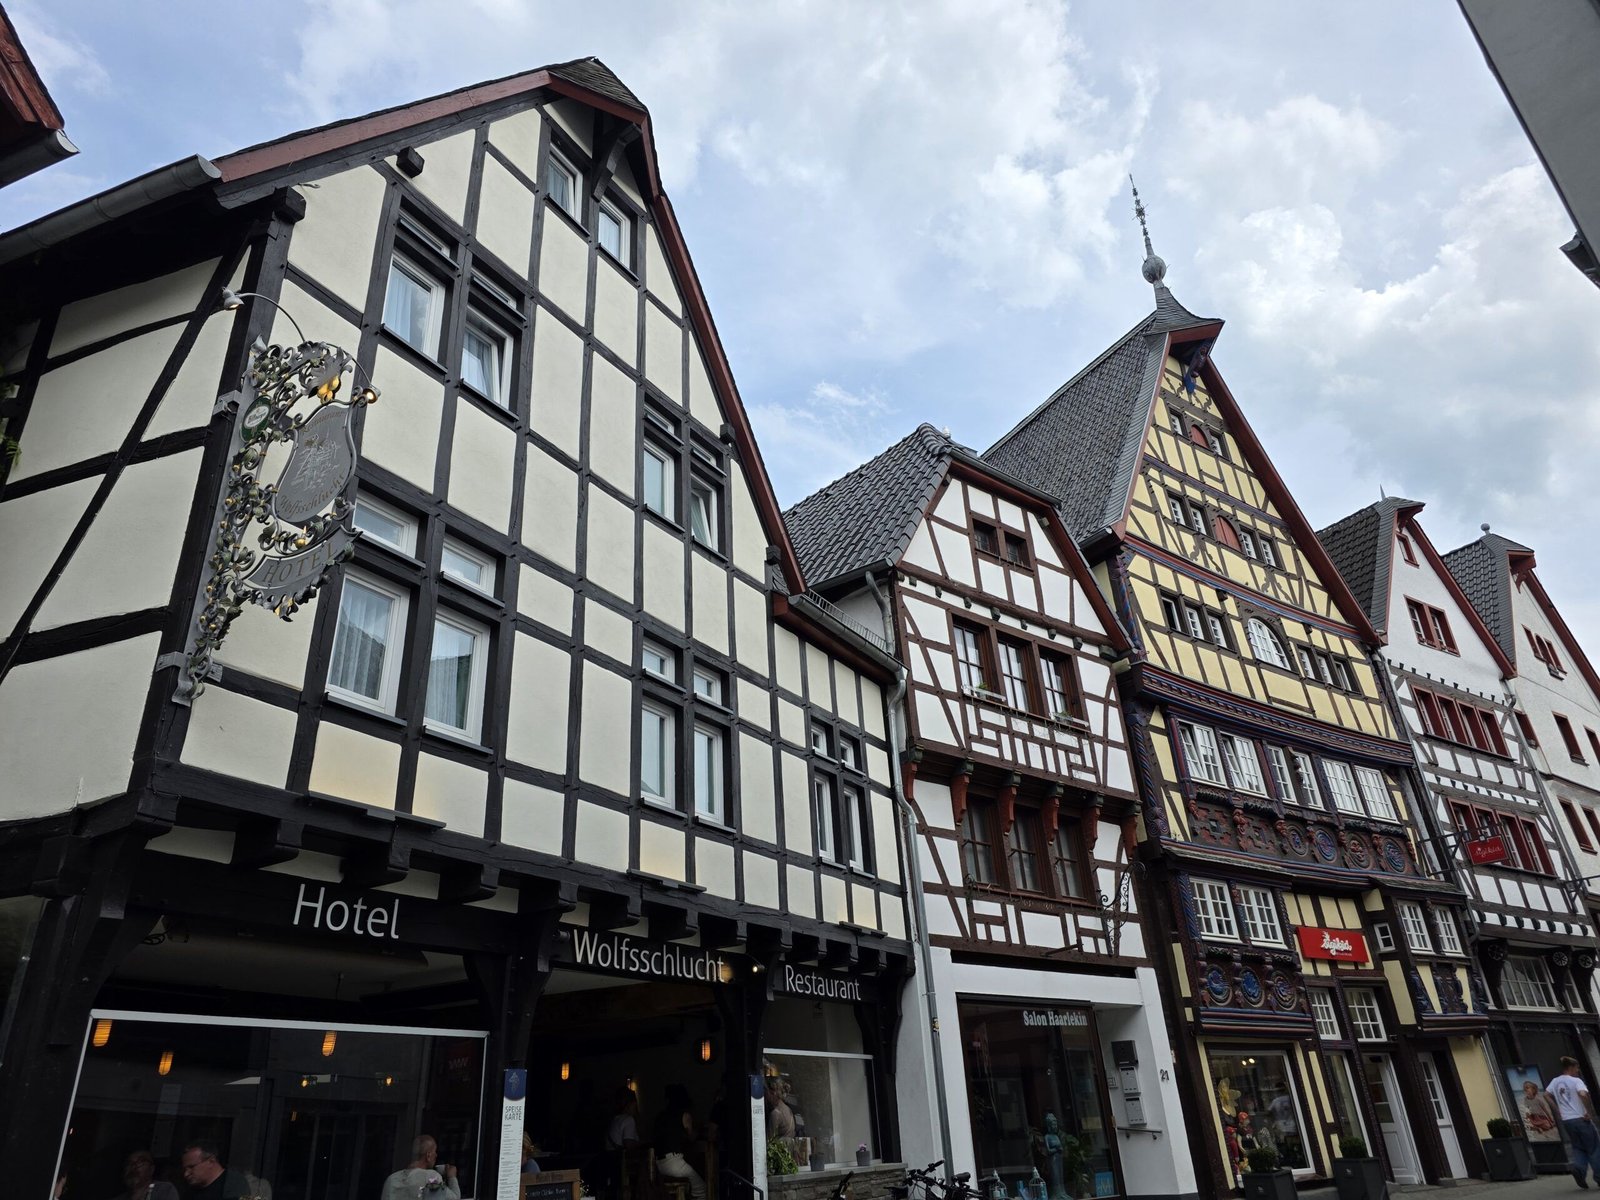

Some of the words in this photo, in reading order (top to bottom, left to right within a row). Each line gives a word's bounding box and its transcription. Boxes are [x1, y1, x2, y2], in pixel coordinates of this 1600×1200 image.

[263, 542, 336, 583] HOTEL
[293, 883, 400, 939] Hotel
[573, 929, 725, 983] Wolfsschlucht
[785, 964, 861, 1000] Restaurant
[1023, 1010, 1047, 1026] Salon
[1047, 1011, 1088, 1026] Haarlekin
[1160, 1069, 1169, 1081] 21
